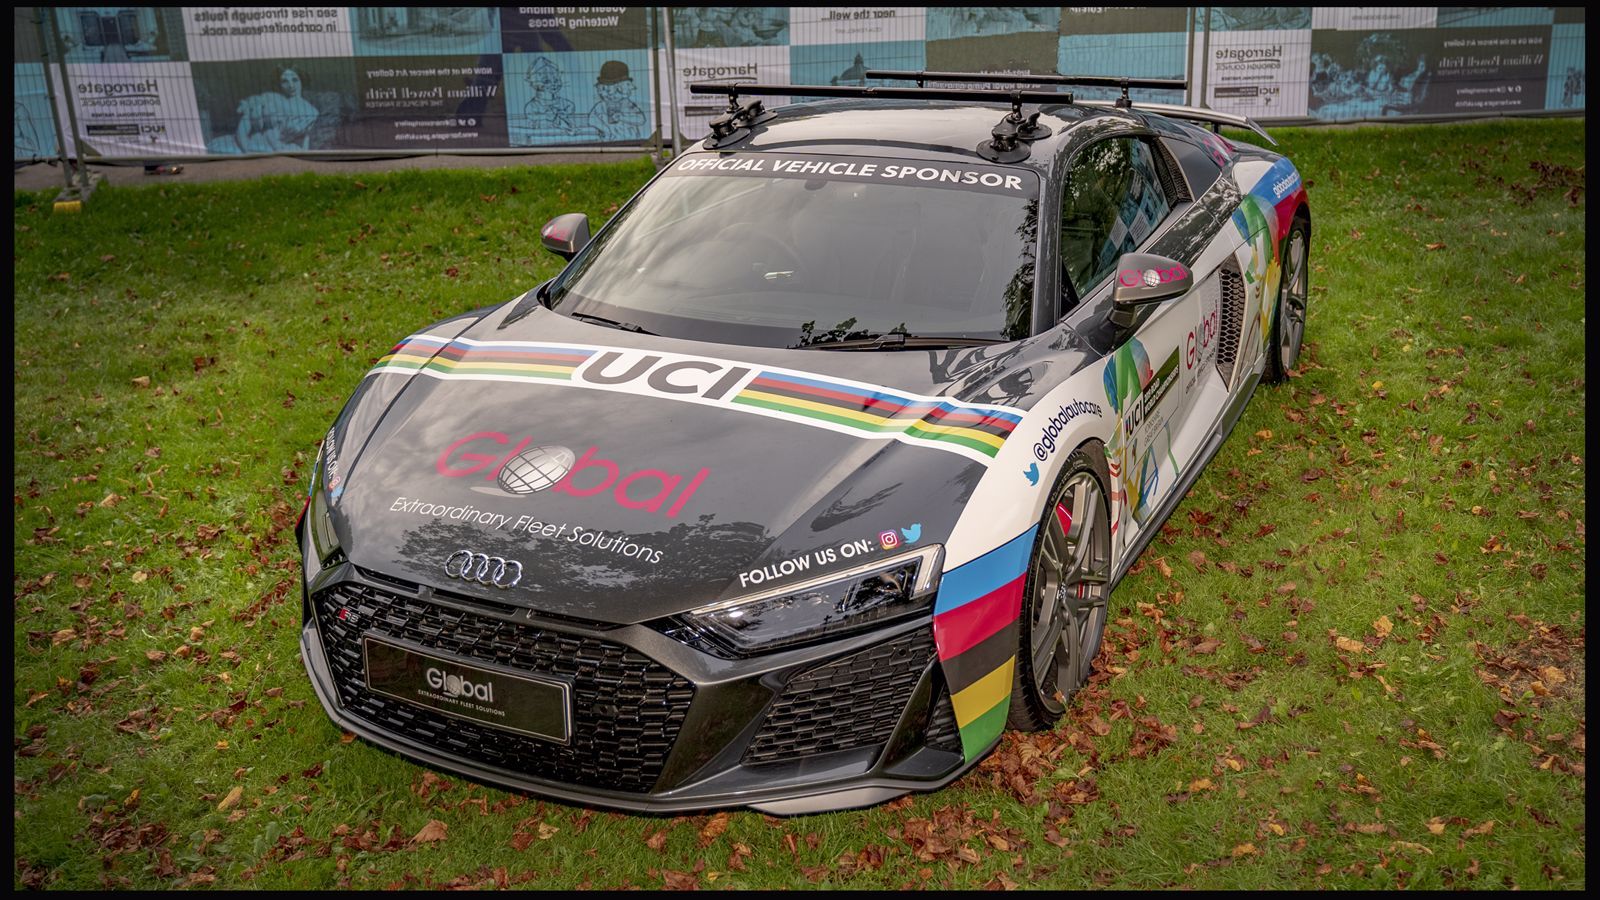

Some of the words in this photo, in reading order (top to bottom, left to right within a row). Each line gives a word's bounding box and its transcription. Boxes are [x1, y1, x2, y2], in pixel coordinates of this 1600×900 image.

[678, 158, 765, 172] OFFICIAL
[772, 160, 878, 177] VEHICLE
[880, 164, 1023, 190] SPONSOR
[582, 351, 752, 400] UCI
[1033, 398, 1102, 462] @globalautocars
[1127, 400, 1144, 436] UCI
[435, 432, 711, 518] Global
[390, 496, 513, 530] Extraordinary
[514, 514, 567, 539] Fleet
[566, 526, 664, 565] Solutions
[738, 556, 811, 588] FOLLOW
[814, 548, 838, 566] US
[840, 538, 874, 560] ON:
[418, 688, 459, 705] EXTRAORDINARY
[460, 700, 475, 709] FLEET
[476, 704, 505, 716] SOLUTIONS
[426, 667, 494, 702] Global
